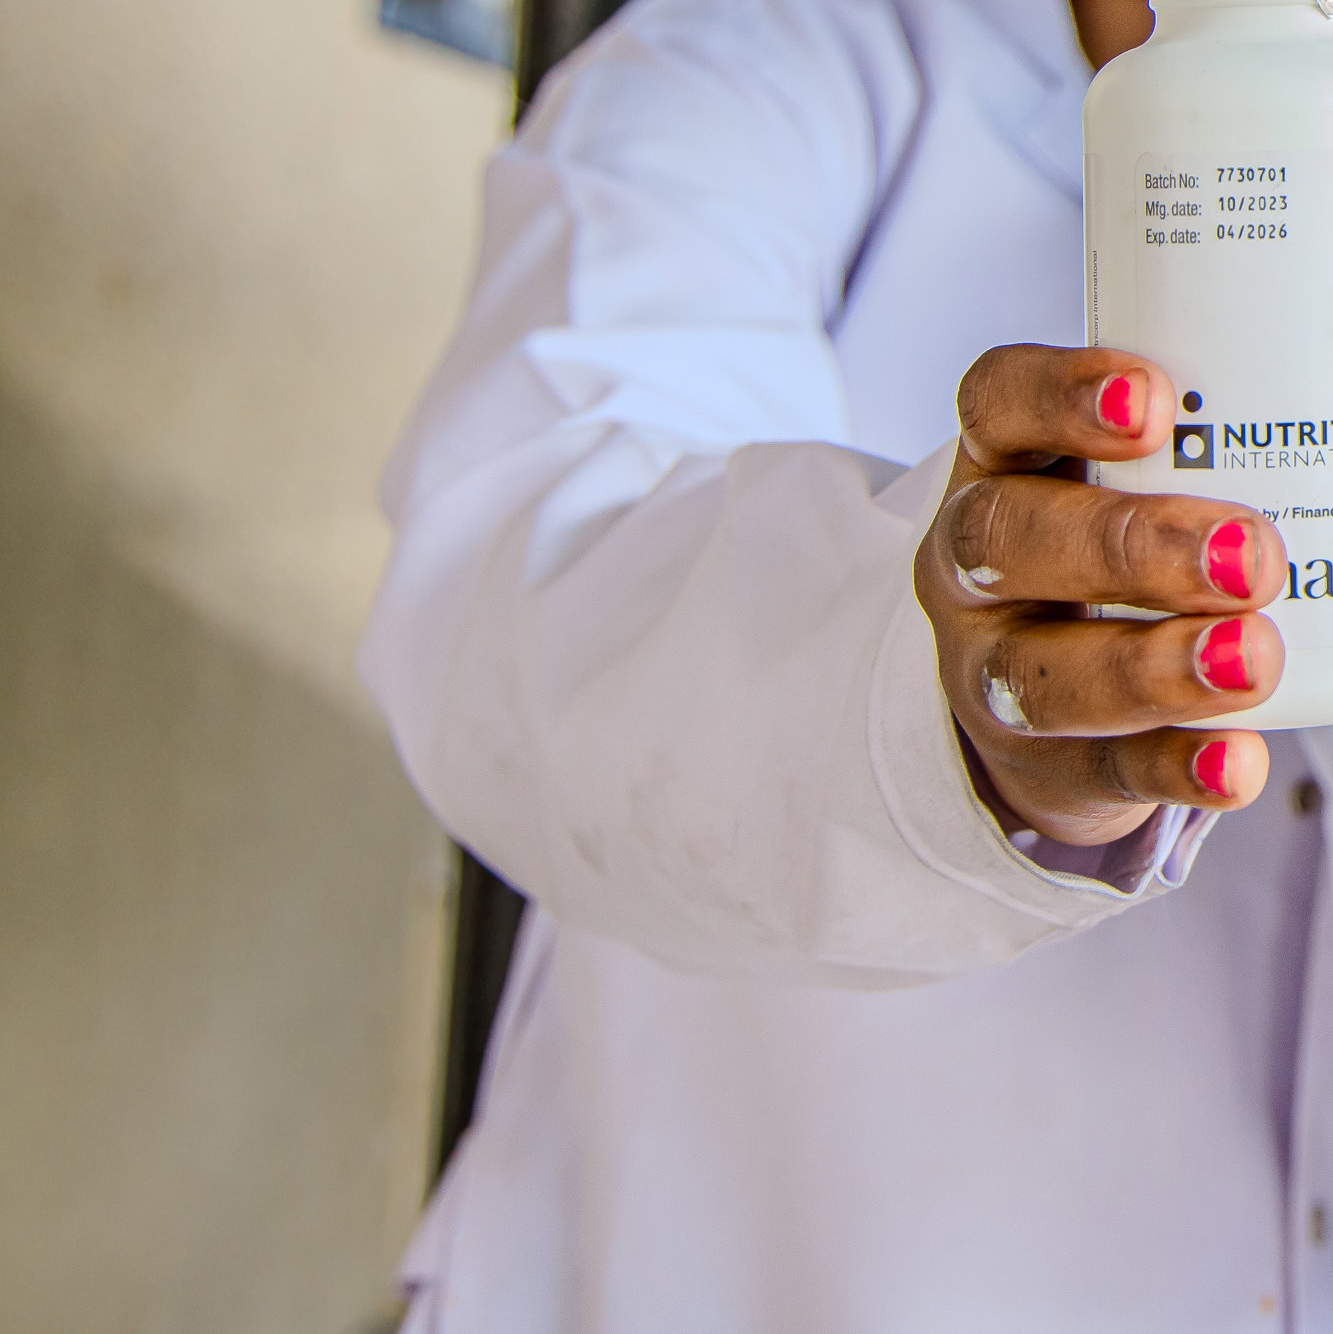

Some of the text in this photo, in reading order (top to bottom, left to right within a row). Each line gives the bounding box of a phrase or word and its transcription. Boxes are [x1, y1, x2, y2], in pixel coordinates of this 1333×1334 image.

[1145, 167, 1286, 189] Batch No: 7730701
[1145, 195, 1288, 220] Mfg. date: 10/2023
[1146, 223, 1288, 247] Exp. date: 04/2026
